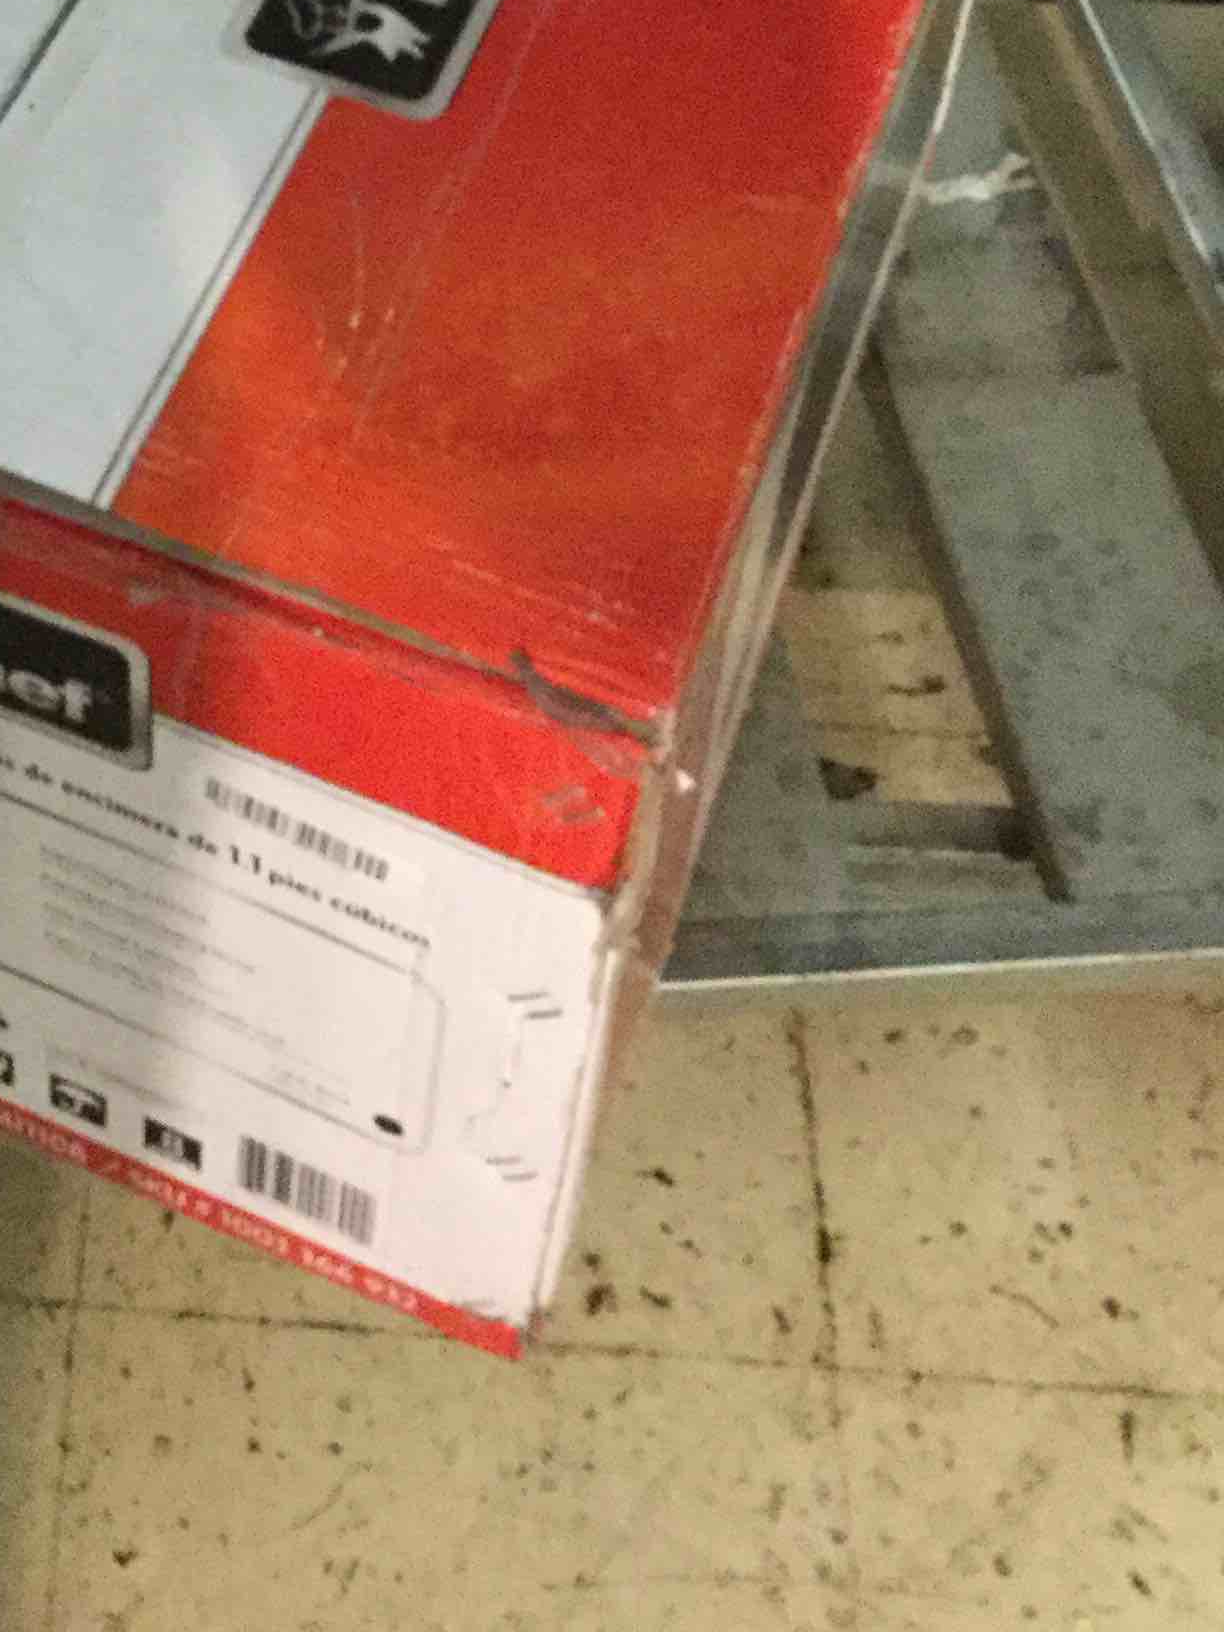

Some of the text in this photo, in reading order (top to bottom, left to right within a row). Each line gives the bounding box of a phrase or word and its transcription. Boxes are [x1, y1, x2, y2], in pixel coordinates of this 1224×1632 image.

[24, 763, 53, 784] de
[187, 833, 217, 856] de
[267, 868, 322, 903] pies
